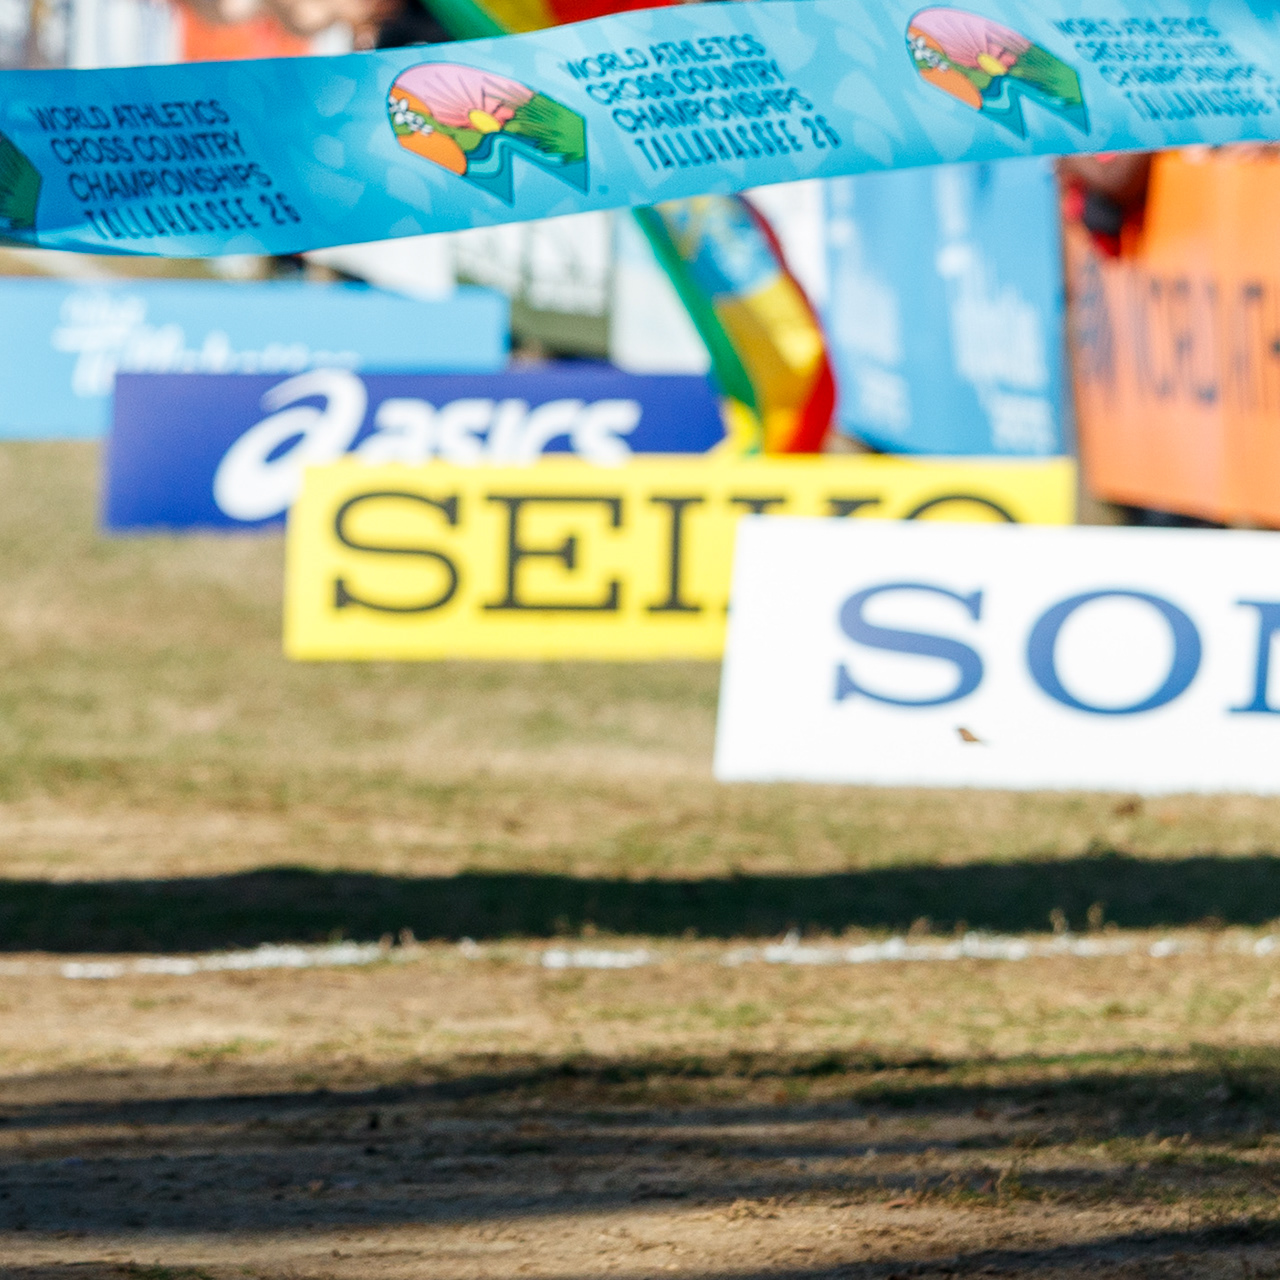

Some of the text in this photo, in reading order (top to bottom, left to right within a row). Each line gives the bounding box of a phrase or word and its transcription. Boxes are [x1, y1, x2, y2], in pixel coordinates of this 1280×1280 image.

[26, 99, 231, 132] WORLD ATHLETICS
[49, 130, 246, 165] CROSS COUNTRY
[66, 161, 273, 202] CHAMPIONSHIPS
[83, 197, 261, 240] TALLAHASSEE
[331, 489, 1021, 614] SEI
